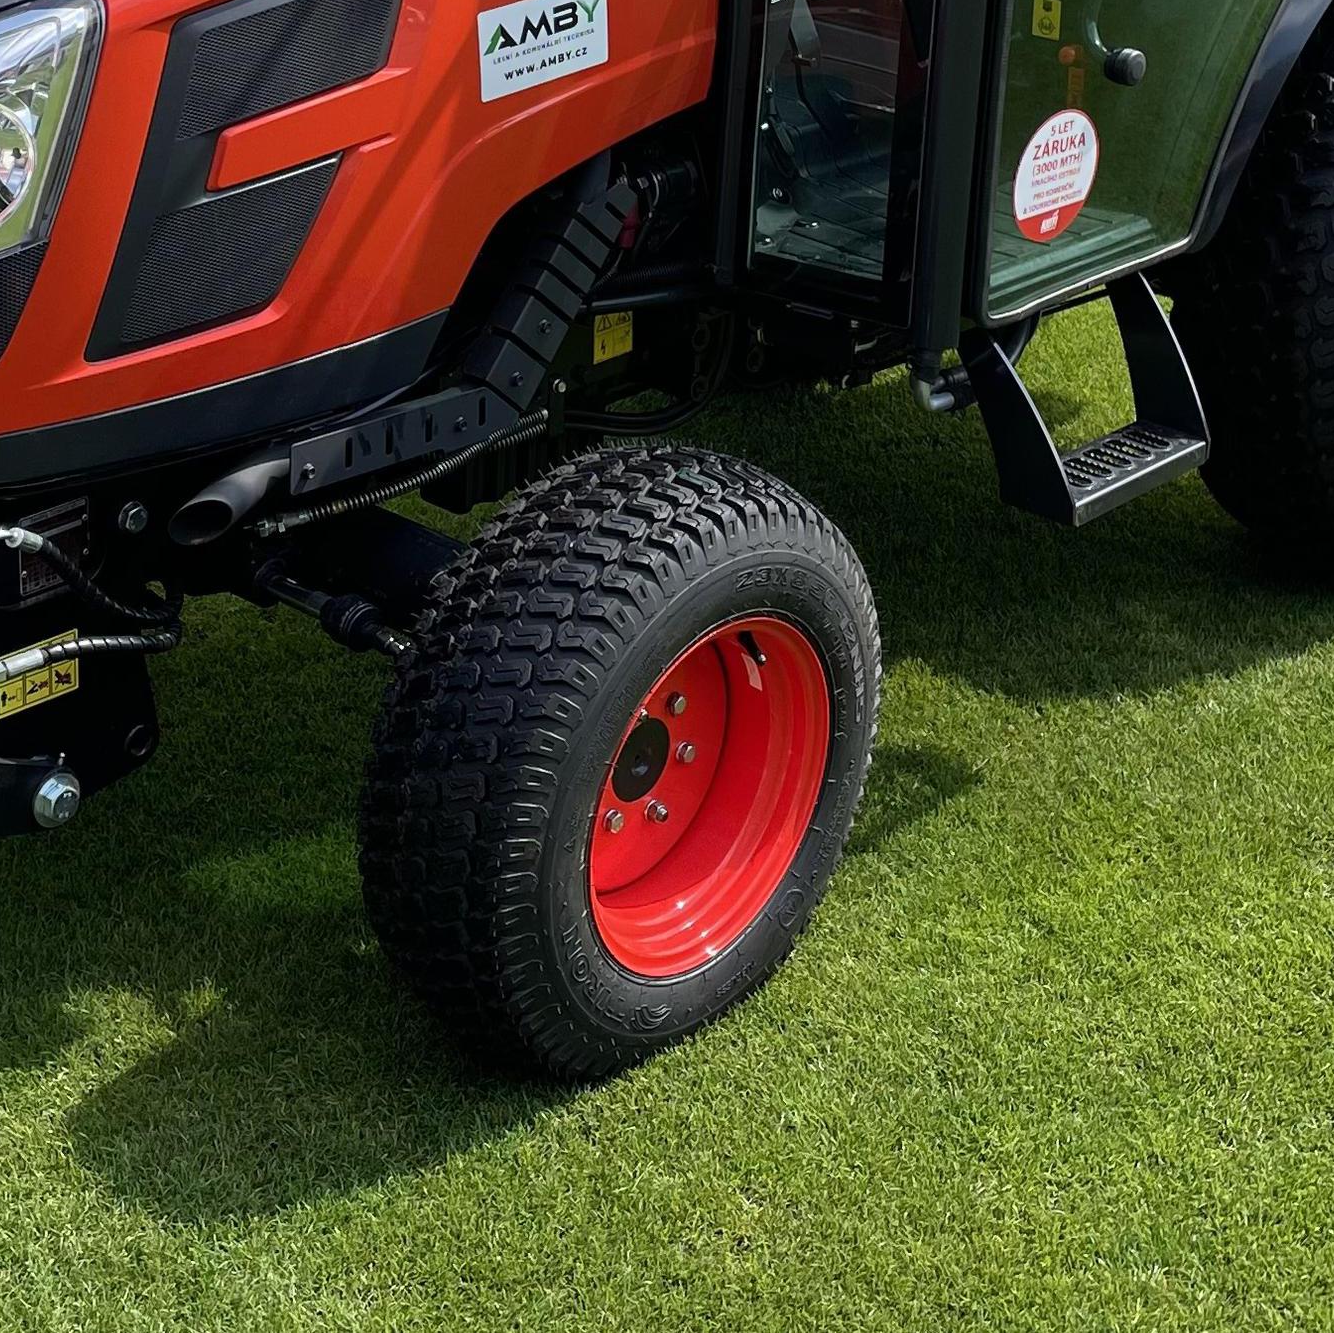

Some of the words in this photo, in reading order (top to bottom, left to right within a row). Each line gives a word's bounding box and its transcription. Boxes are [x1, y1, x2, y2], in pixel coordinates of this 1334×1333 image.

[504, 47, 588, 81] WWW.AMBY.CZ
[1059, 120, 1075, 135] LET
[1032, 132, 1086, 161] ZÁRUKA
